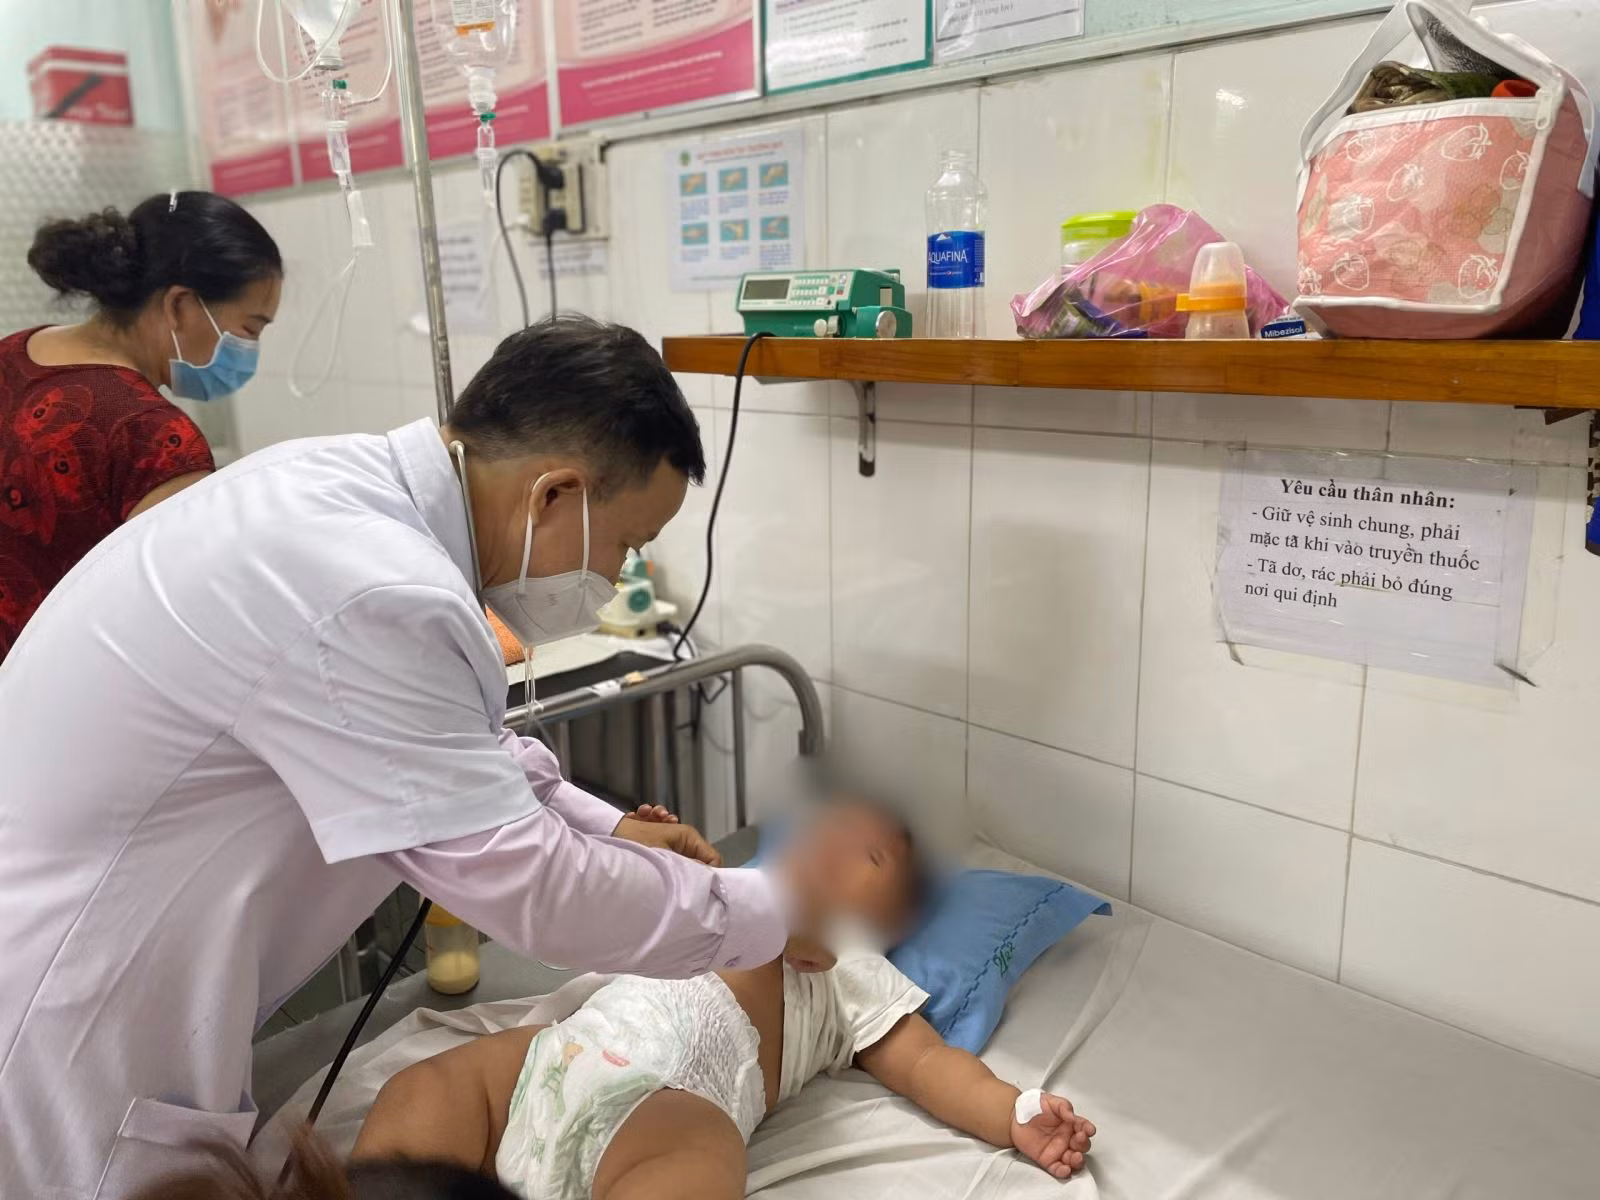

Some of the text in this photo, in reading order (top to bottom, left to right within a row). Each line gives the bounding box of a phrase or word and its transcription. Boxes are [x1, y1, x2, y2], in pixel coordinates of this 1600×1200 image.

[1264, 325, 1303, 338] Mibezisol
[1281, 478, 1455, 509] Yêu cầu thân nhân:
[1262, 506, 1292, 522] Giữ
[1297, 510, 1316, 527] vệ
[1319, 511, 1352, 529] sinh
[1358, 516, 1415, 540] chung,
[1421, 522, 1461, 541] phải
[1249, 532, 1280, 548] mặc
[1304, 535, 1329, 552] khi
[1335, 540, 1363, 556] vào
[1369, 543, 1423, 565] truyền
[1429, 549, 1480, 571] thuốc
[1245, 583, 1338, 608] nơi qui định
[1258, 558, 1277, 574] Tã
[1282, 562, 1306, 580] dơ,
[1311, 566, 1336, 582] rác
[1341, 570, 1376, 588] phải
[1382, 574, 1403, 591] bỏ
[1408, 578, 1454, 602] đúng
